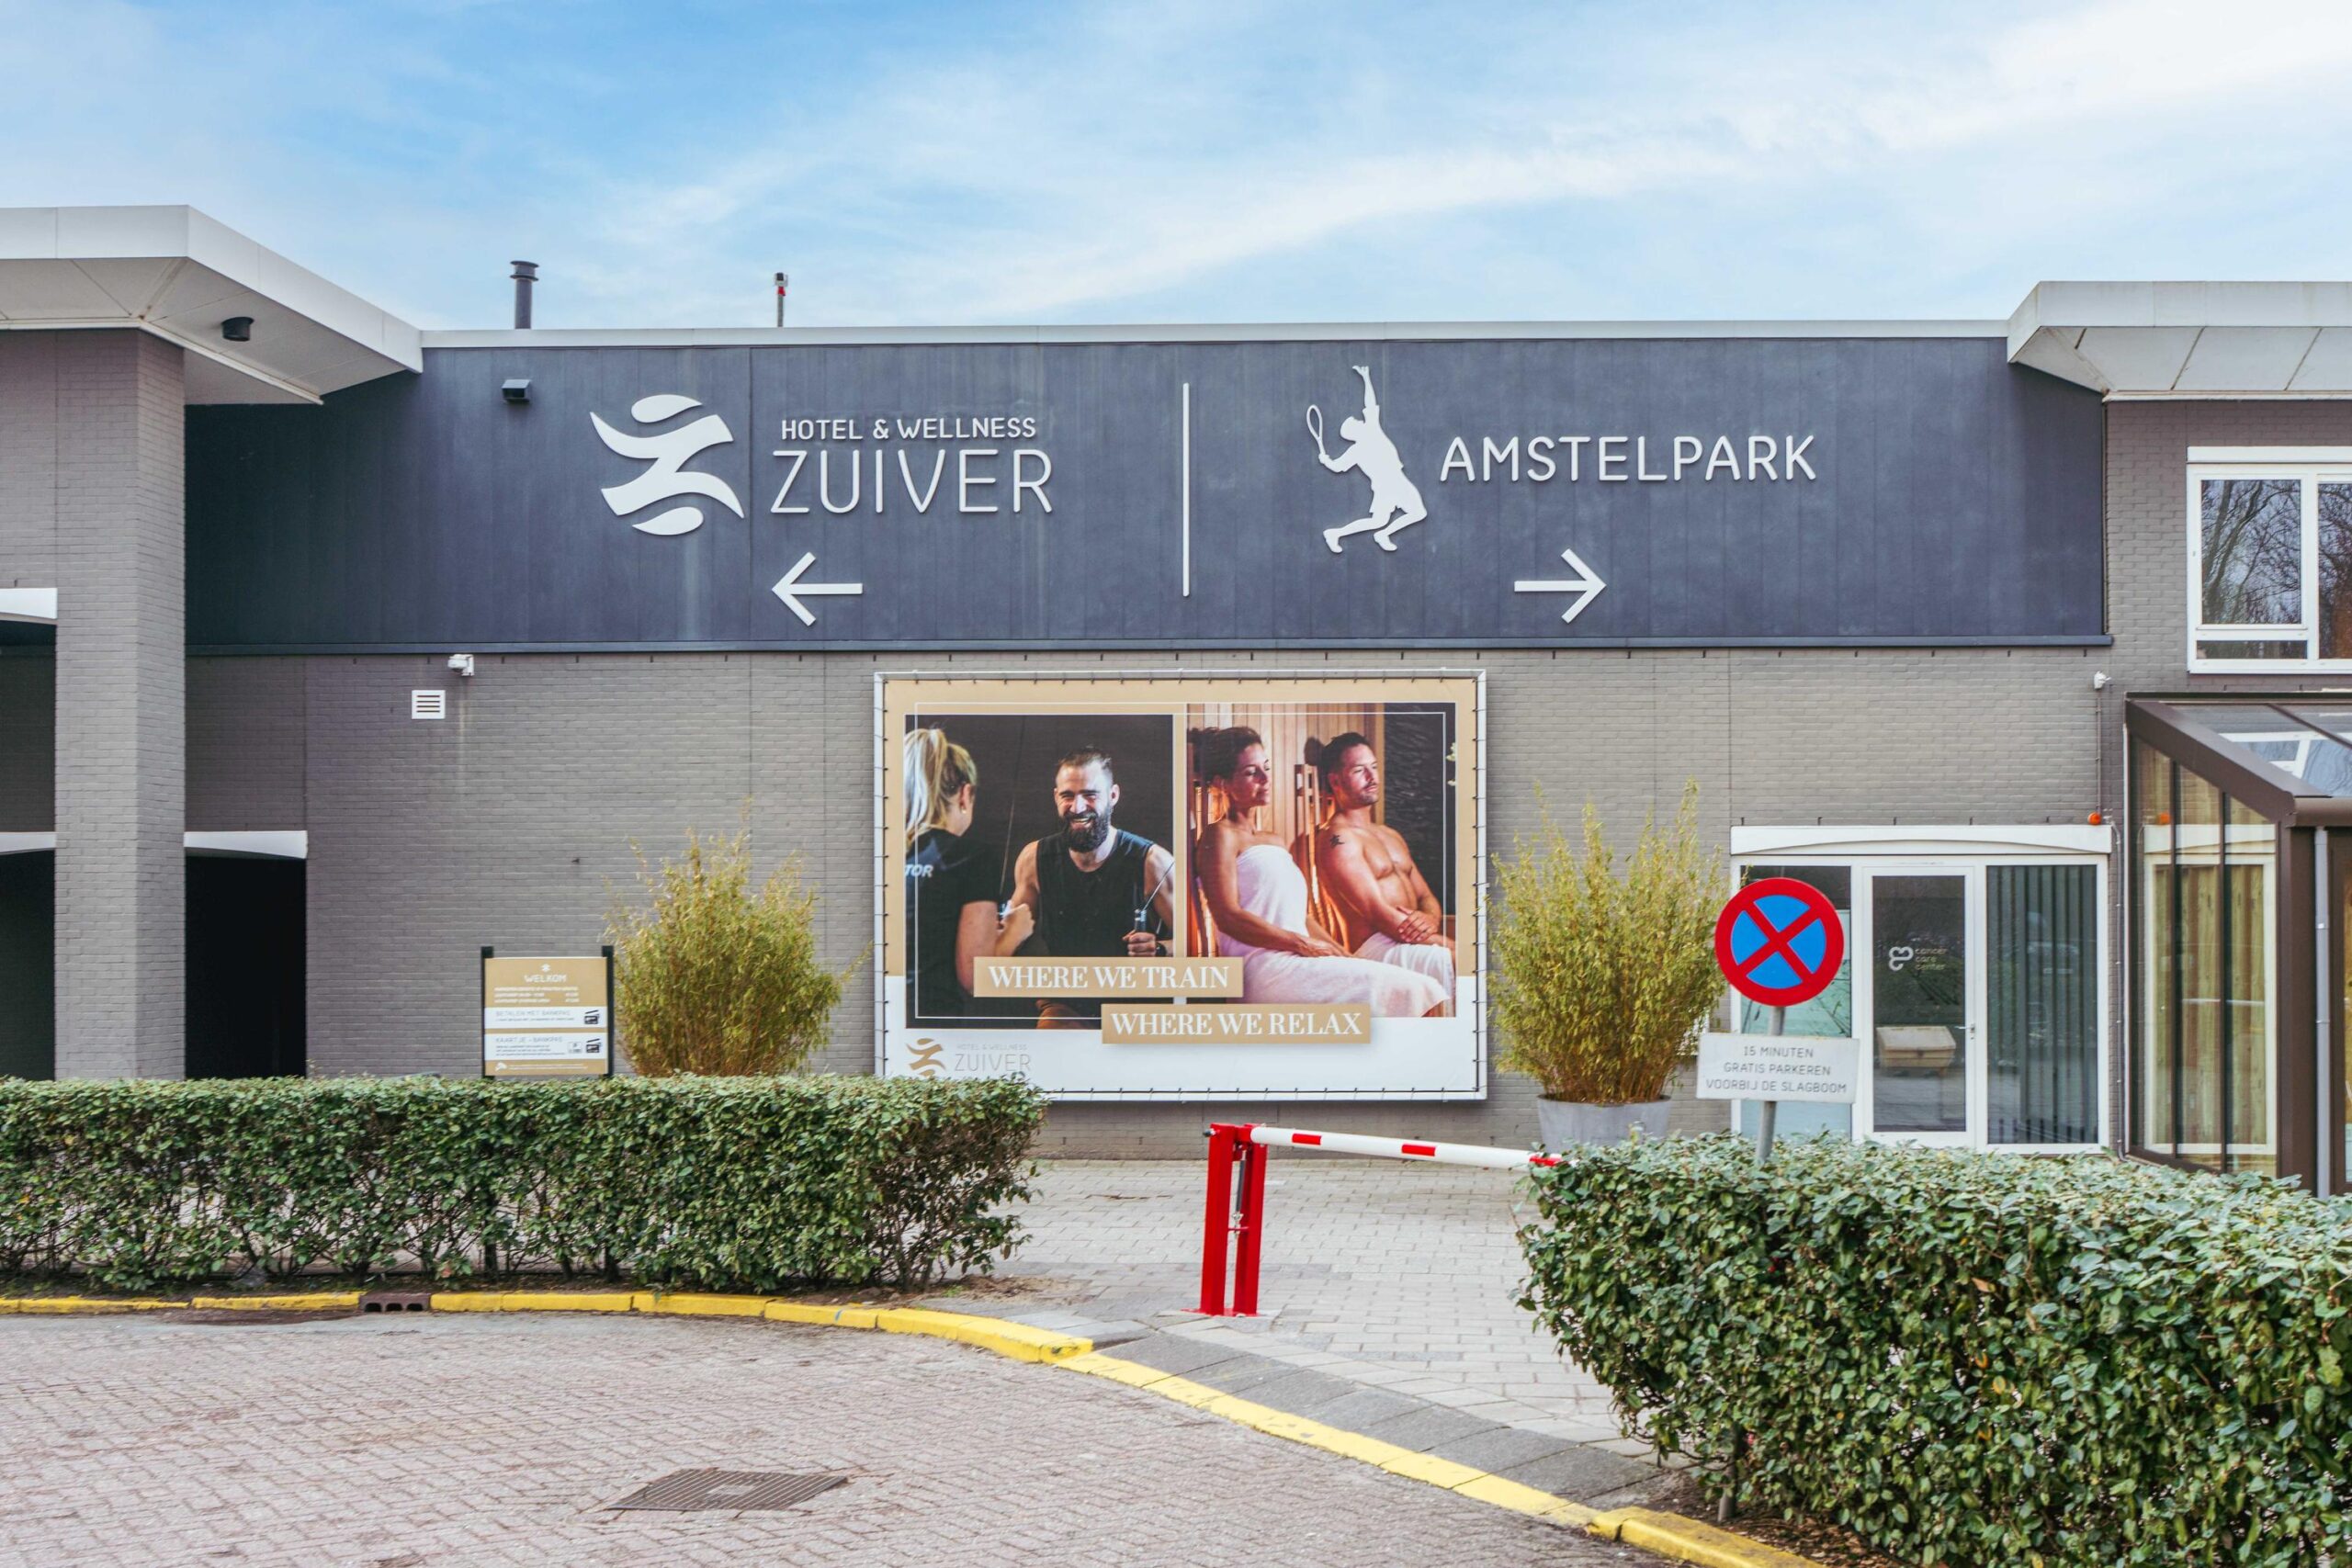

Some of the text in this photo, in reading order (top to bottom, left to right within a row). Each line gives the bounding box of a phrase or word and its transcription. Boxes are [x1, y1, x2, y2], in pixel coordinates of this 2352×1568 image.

[781, 417, 1036, 440] HOTEL & WELLNESS
[1440, 434, 1816, 482] AMSTELPARK
[770, 448, 1053, 514] ZUIVER
[524, 974, 567, 983] WELKOM
[989, 966, 1229, 988] WHERE WE TRAIN
[1111, 1012, 1363, 1035] WHERE WE RELAX
[1744, 1046, 1814, 1058] 15 MINUTEN
[955, 1054, 1031, 1072] ZUIVER
[1724, 1062, 1831, 1076] GRATIS PARKEREN
[1705, 1078, 1847, 1093] VOORBIJ DE SLAGBOOM
